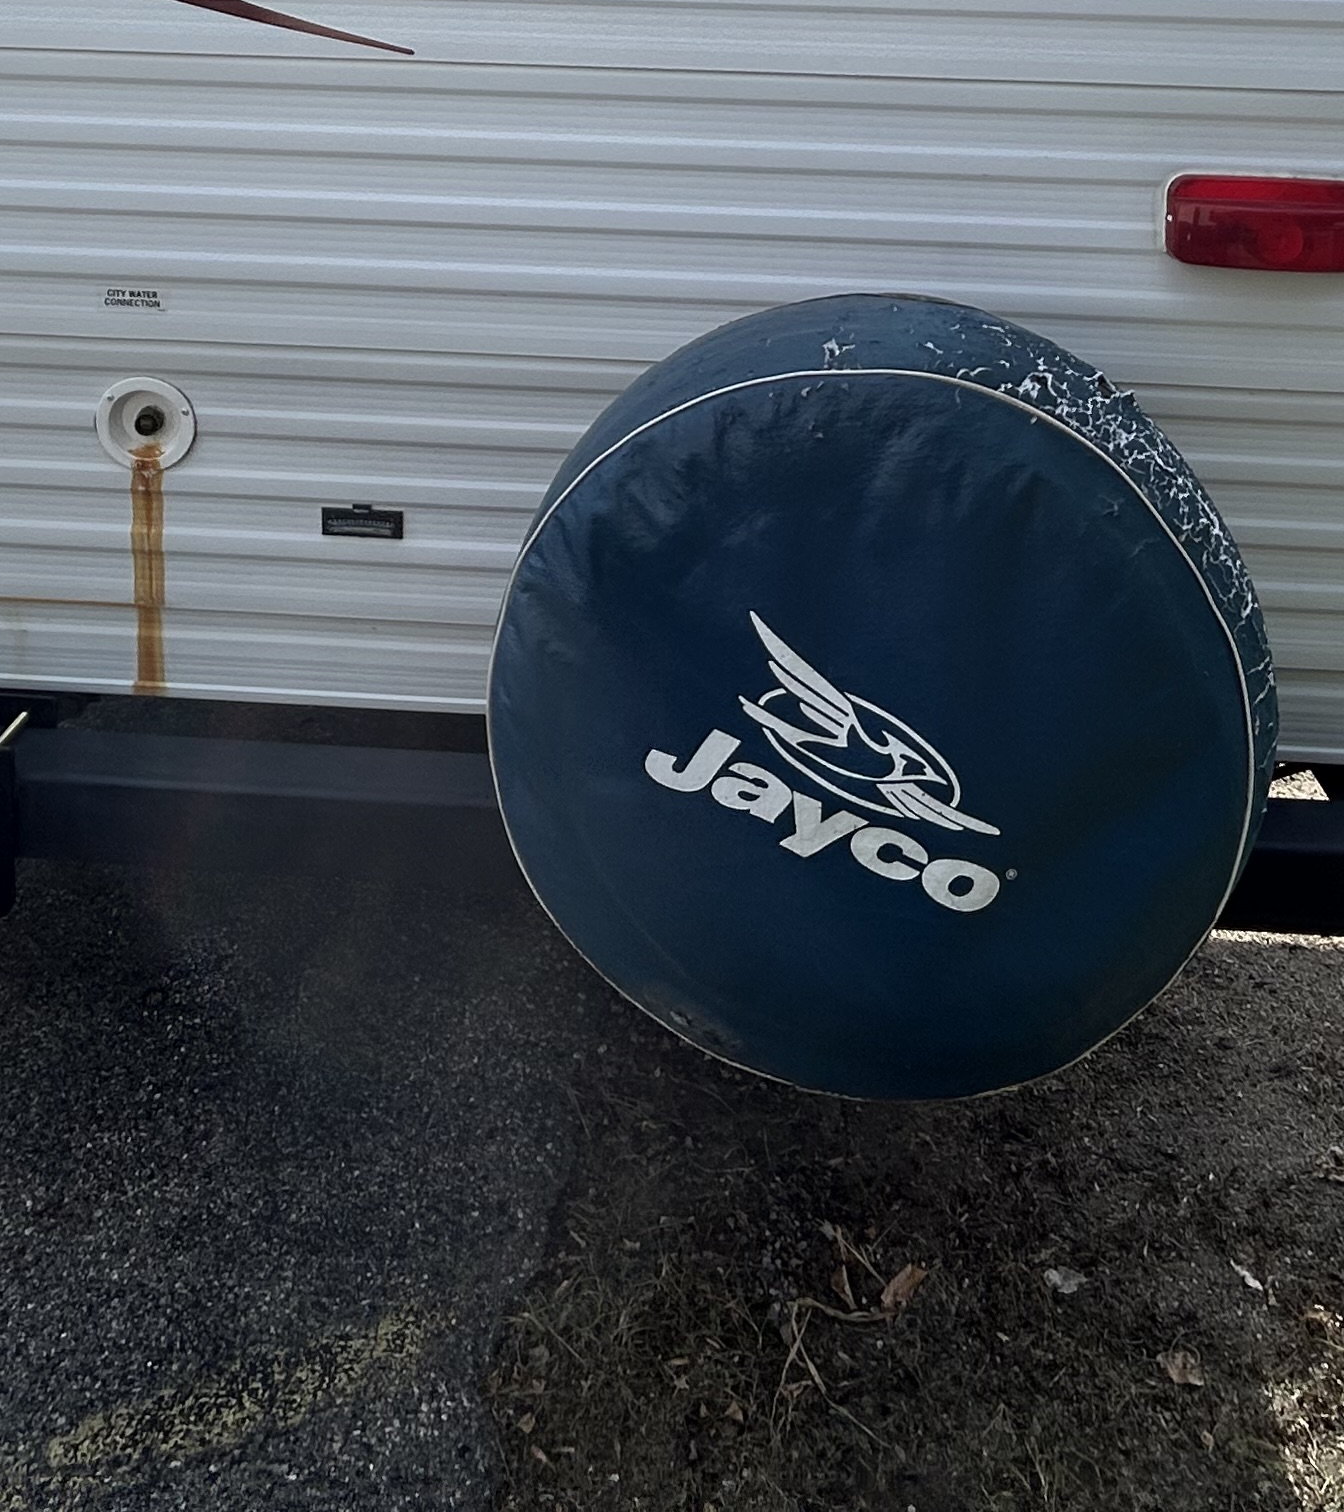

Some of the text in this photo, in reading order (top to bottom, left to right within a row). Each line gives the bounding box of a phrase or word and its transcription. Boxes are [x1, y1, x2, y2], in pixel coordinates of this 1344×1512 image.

[107, 288, 158, 299] CITY WATER
[104, 297, 161, 308] CONNECTION
[644, 728, 1000, 912] Jayco
